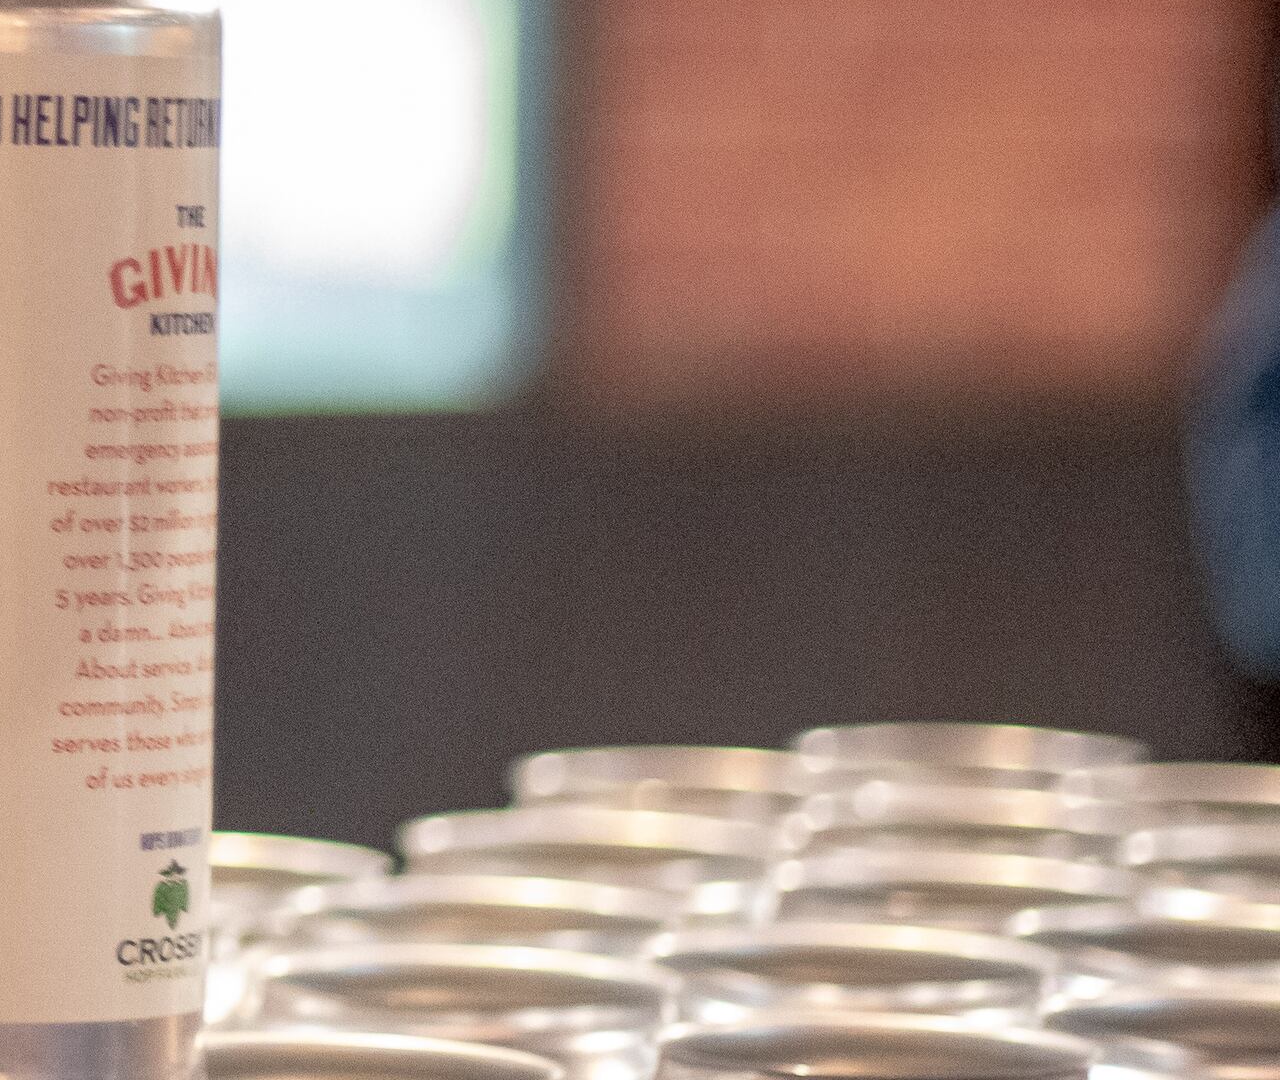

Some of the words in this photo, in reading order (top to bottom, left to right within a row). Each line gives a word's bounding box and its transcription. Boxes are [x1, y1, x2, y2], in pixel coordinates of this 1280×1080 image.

[12, 92, 141, 148] HELPING
[176, 204, 206, 228] THE
[108, 242, 218, 310] GIVIN
[91, 363, 152, 392] Giving
[84, 443, 179, 465] emergency
[47, 477, 151, 497] restaurant
[50, 509, 76, 533] of
[63, 554, 111, 570] over
[55, 589, 70, 610] 5
[79, 628, 92, 643] a
[76, 657, 137, 680] About
[52, 738, 121, 753] serves
[126, 731, 171, 752] those
[86, 766, 109, 789] of
[113, 775, 134, 790] us
